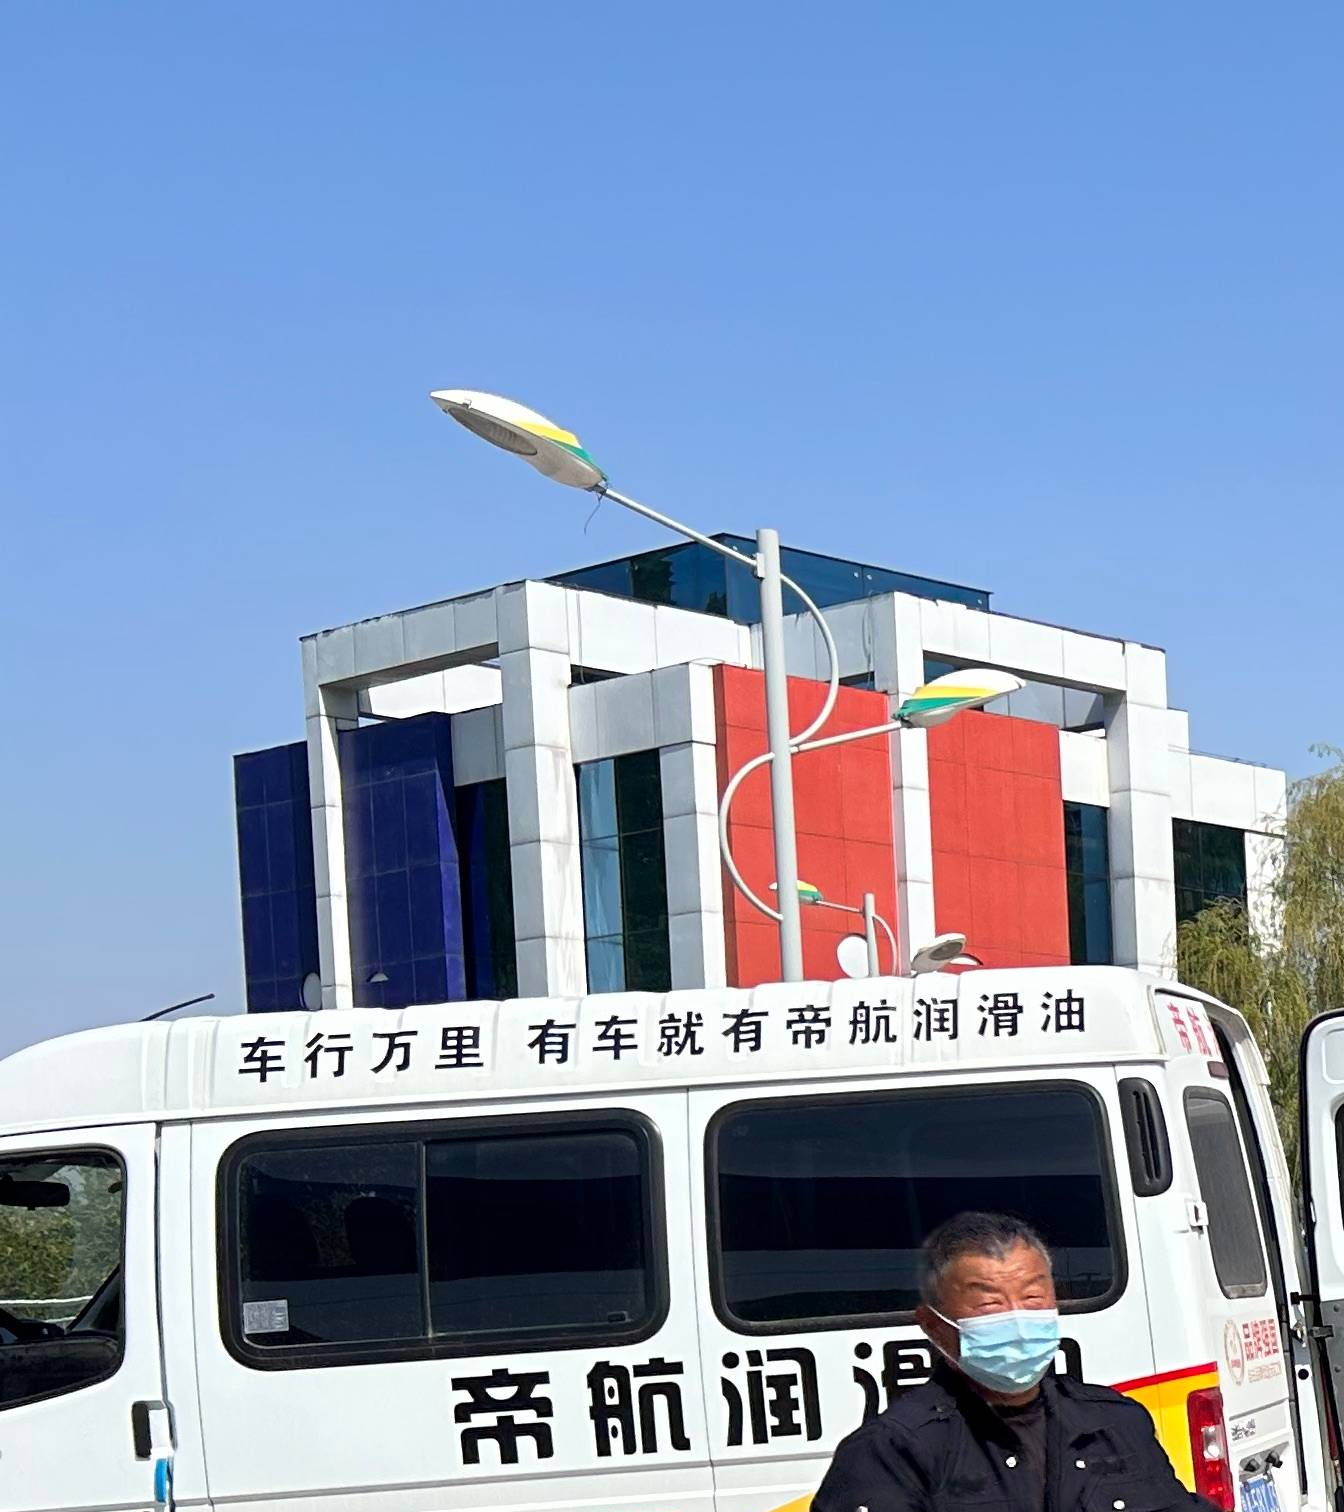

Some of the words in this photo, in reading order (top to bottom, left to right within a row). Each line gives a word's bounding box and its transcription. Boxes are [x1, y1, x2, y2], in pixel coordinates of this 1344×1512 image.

[238, 1026, 484, 1082] 车行万里
[528, 989, 1086, 1064] 有车就有帝航润滑油
[451, 1337, 1085, 1465] 帝航润
